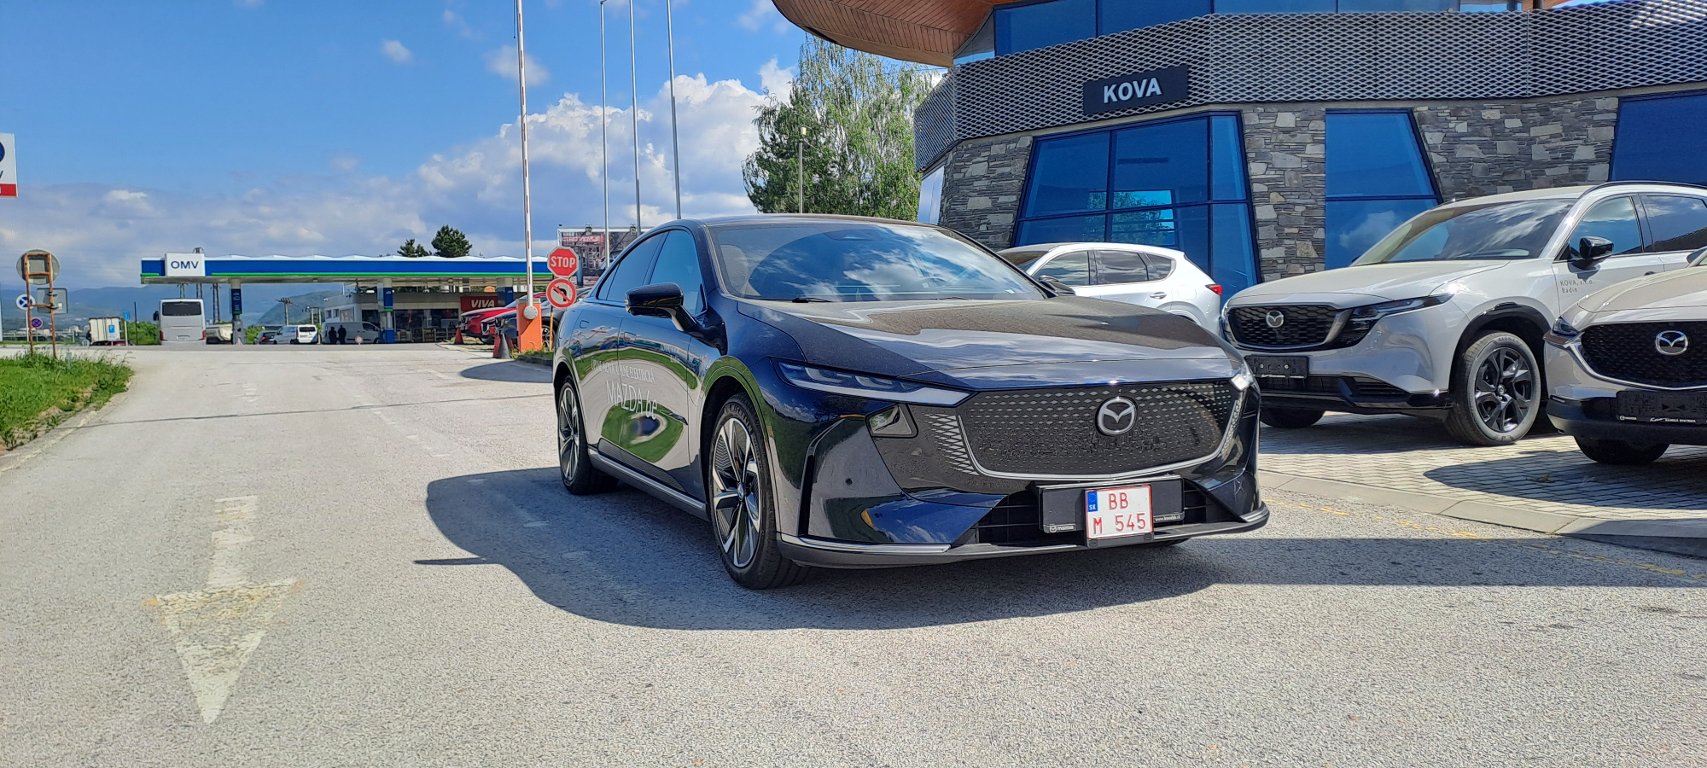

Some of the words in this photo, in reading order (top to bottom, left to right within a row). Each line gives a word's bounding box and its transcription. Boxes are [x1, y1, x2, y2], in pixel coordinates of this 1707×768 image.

[1103, 78, 1162, 104] KOVA
[170, 260, 199, 269] OMV
[550, 256, 576, 268] STOP
[471, 299, 495, 308] VIVA
[606, 380, 643, 414] MAZDA
[1108, 492, 1129, 510] BB
[1093, 517, 1103, 535] M
[1115, 513, 1146, 532] 545
